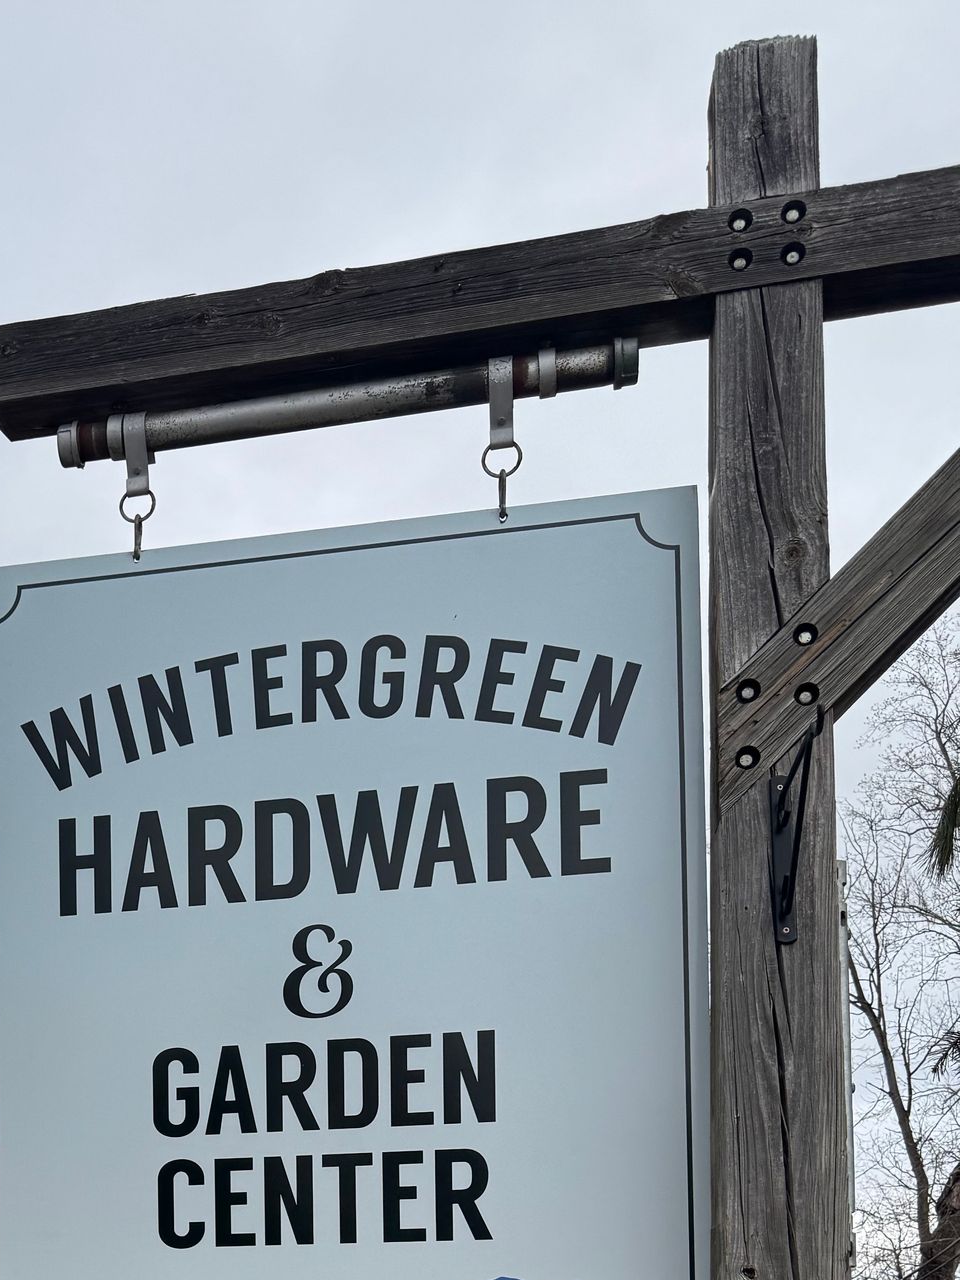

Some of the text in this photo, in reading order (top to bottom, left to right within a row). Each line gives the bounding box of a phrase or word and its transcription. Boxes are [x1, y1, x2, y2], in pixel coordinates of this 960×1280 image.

[20, 634, 643, 792] WINTERGREEN
[58, 768, 612, 917] HARDWARE
[282, 923, 354, 1019] &
[152, 1029, 497, 1138] GARDEN
[157, 1148, 494, 1250] CENTER
